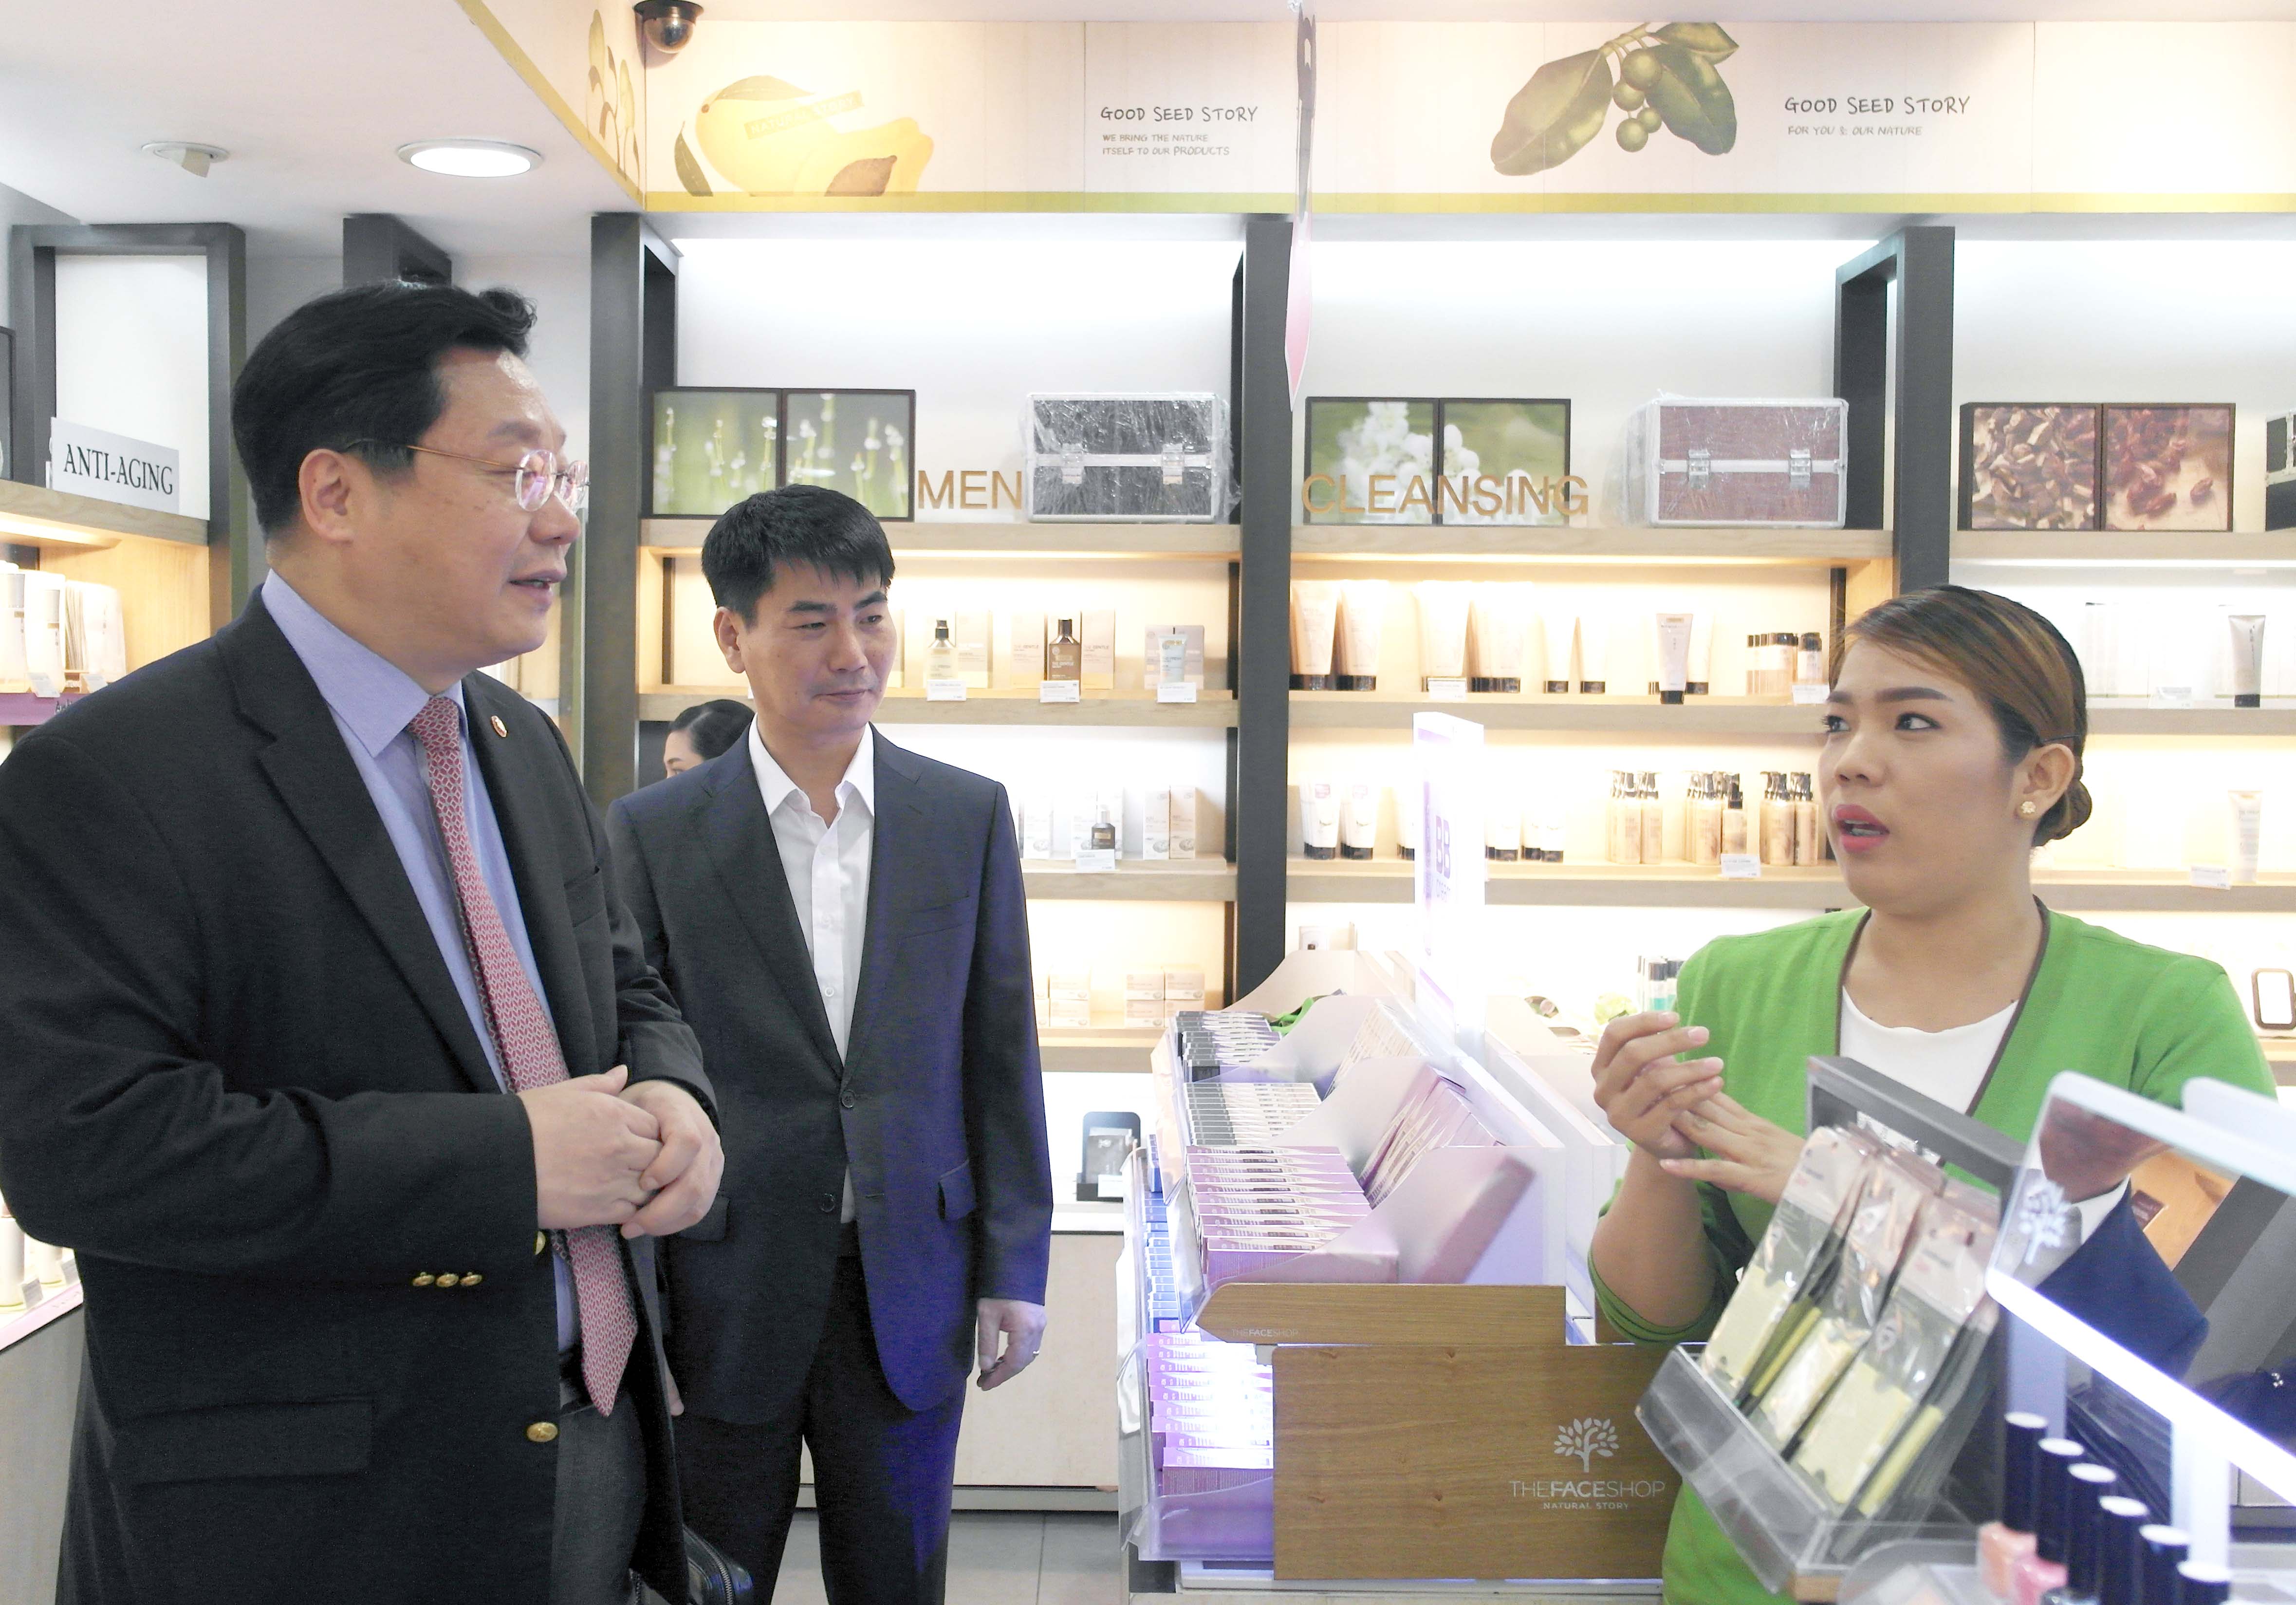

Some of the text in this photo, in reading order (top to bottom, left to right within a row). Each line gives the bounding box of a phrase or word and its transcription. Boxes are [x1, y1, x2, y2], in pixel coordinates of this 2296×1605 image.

[1785, 96, 1970, 114] GOOD SEED STORY
[1101, 106, 1258, 122] GOOD SEED STORY
[1119, 133, 1148, 142] BRING
[1152, 134, 1169, 142] THE
[1172, 134, 1208, 142] NATURE
[1788, 126, 1809, 135] FOR
[1813, 126, 1834, 135] YOU
[1852, 126, 1874, 135] OUR
[1878, 126, 1923, 136] NATURE
[1152, 147, 1170, 155] OUR
[1173, 146, 1230, 156] PRODUCTS
[63, 444, 173, 495] ANTI-AGING
[918, 470, 1022, 509] MEN
[1301, 474, 1589, 516] CLEANSING
[1509, 1481, 1665, 1497] THEFACESHOP
[1596, 1502, 1629, 1510] STORY
